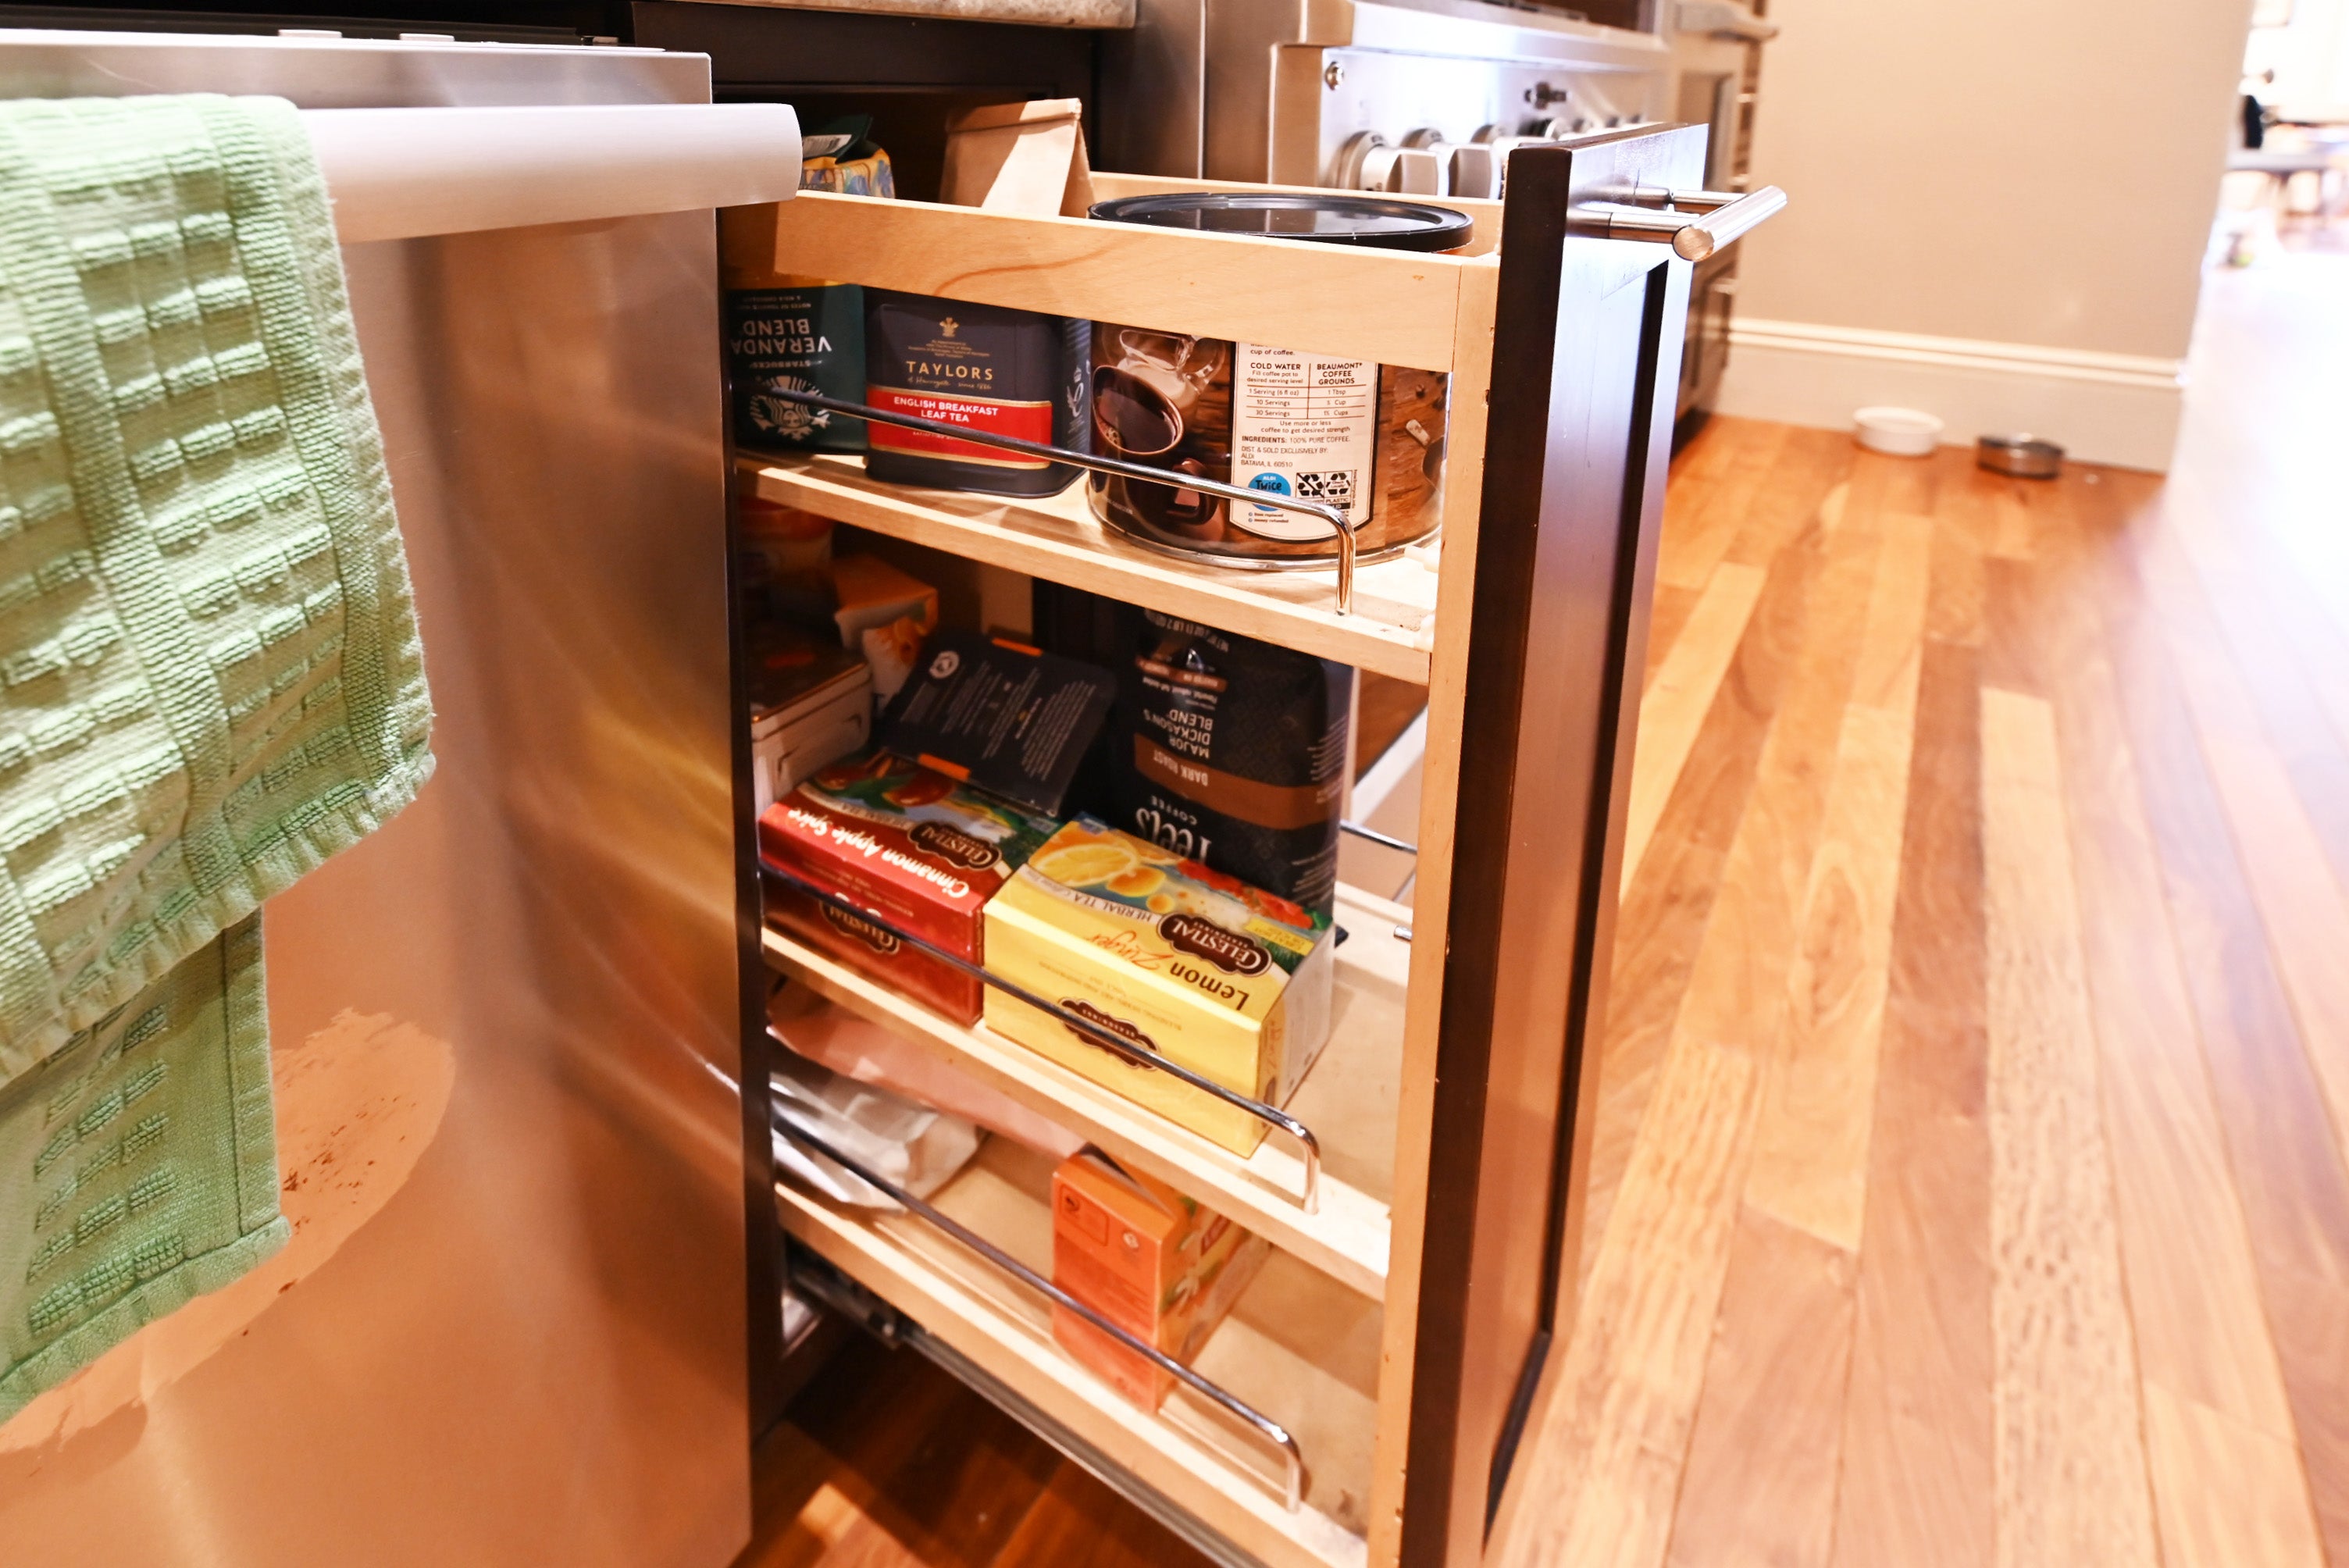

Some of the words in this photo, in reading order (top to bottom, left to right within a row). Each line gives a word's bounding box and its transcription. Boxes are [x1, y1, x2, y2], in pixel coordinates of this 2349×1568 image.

[743, 319, 811, 336] BLEND
[731, 336, 832, 355] VERANDA
[750, 360, 811, 369] STARBUCKS
[906, 361, 993, 380] TAYLORS
[893, 396, 936, 409] ENGLISH
[938, 401, 998, 415] BREAKFAST
[921, 410, 946, 419] LEAF
[949, 412, 970, 422] TEA
[1256, 479, 1282, 491] Twice
[1142, 708, 1210, 745] DICKASON'S
[1170, 709, 1214, 730] BLEND
[1169, 736, 1210, 759] MAJOR
[1182, 764, 1209, 786] DARK
[1151, 794, 1198, 825] COFFEE
[788, 807, 834, 836] Spice
[831, 826, 884, 857] Apple
[921, 826, 993, 866] CELESTIAL
[881, 847, 969, 899] Cinnamon
[1074, 893, 1100, 909] TEA
[1103, 899, 1153, 923] HERBAL
[1092, 929, 1174, 971] Zinger
[1172, 919, 1262, 971] CELESTIAL
[1170, 961, 1250, 1011] Lemon
